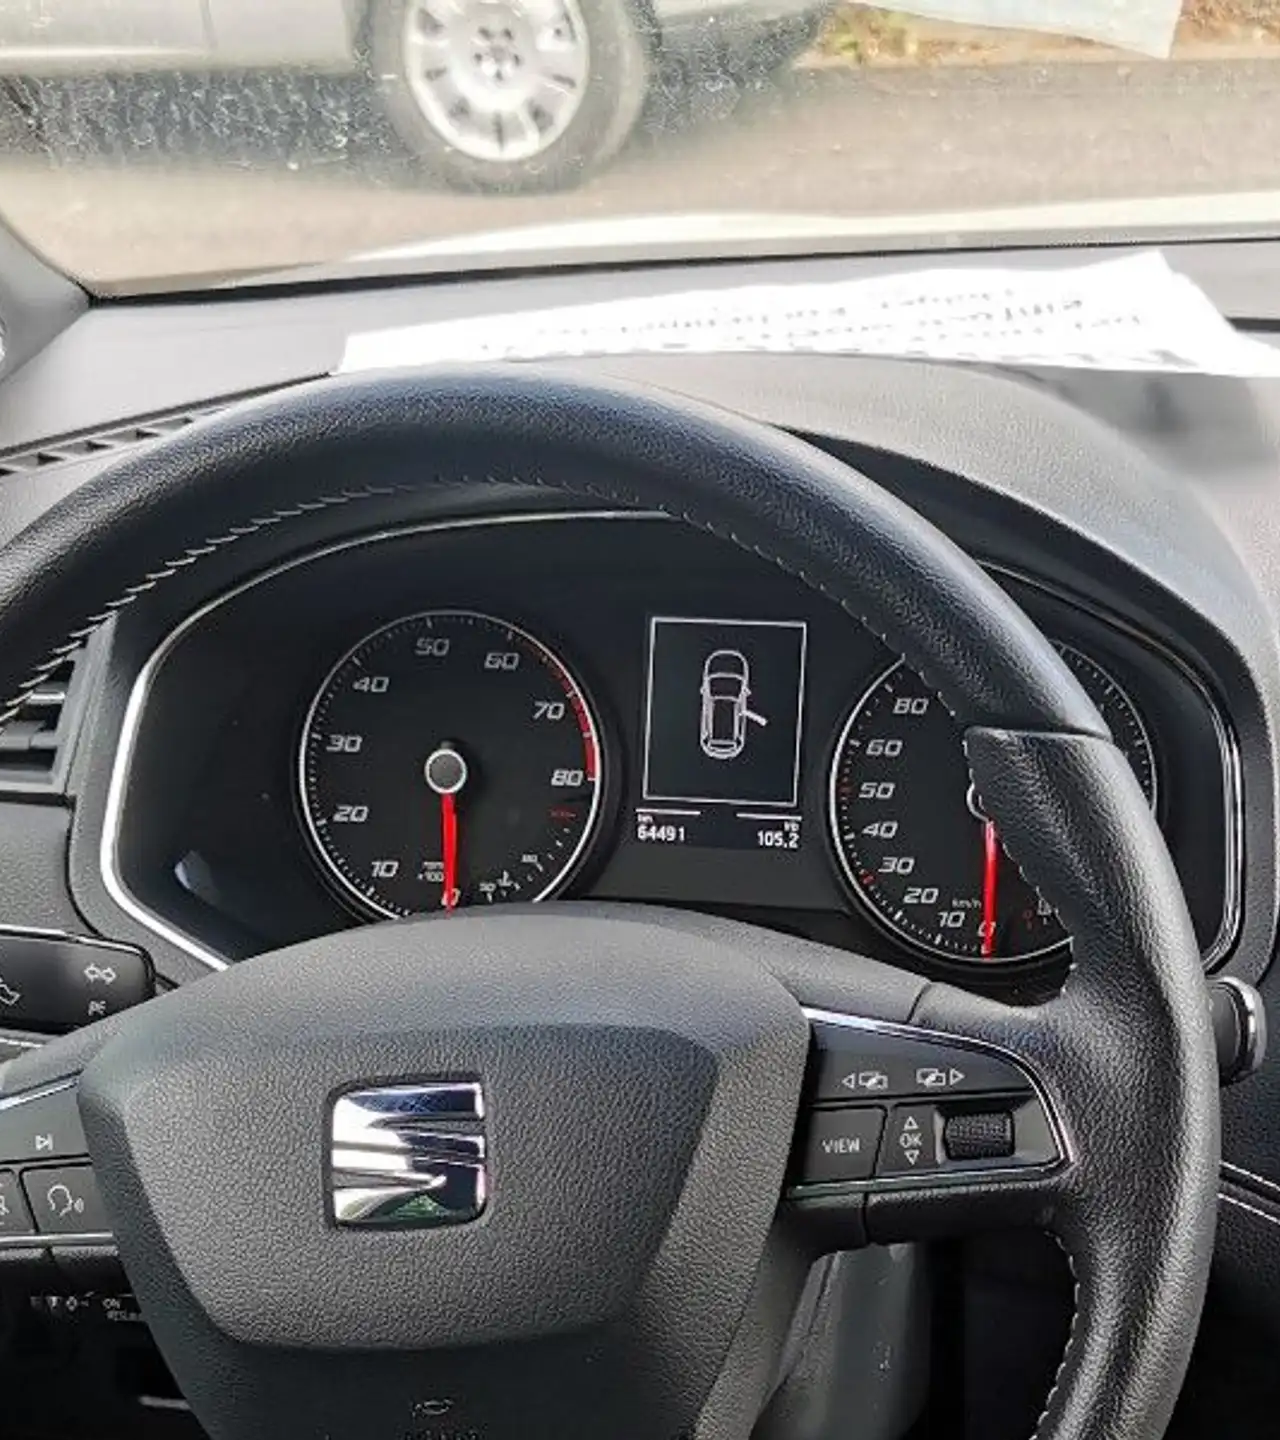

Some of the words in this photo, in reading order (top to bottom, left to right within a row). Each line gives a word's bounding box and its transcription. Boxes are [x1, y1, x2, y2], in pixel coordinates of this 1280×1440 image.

[415, 638, 450, 657] 50
[484, 653, 520, 670] 60
[352, 676, 390, 693] 40
[532, 702, 565, 720] 70
[892, 698, 929, 715] 80
[326, 735, 362, 753] 30
[866, 740, 903, 756] 60
[550, 770, 584, 787] 80
[859, 782, 895, 798] 50
[333, 805, 368, 822] 20
[637, 825, 685, 841] 64491
[862, 821, 898, 838] 40
[757, 831, 799, 848] 105.2
[371, 861, 399, 878] 10
[878, 857, 914, 873] 30
[903, 888, 939, 904] 20
[937, 911, 965, 927] 10
[822, 1137, 861, 1154] VIEW
[899, 1134, 922, 1148] OK
